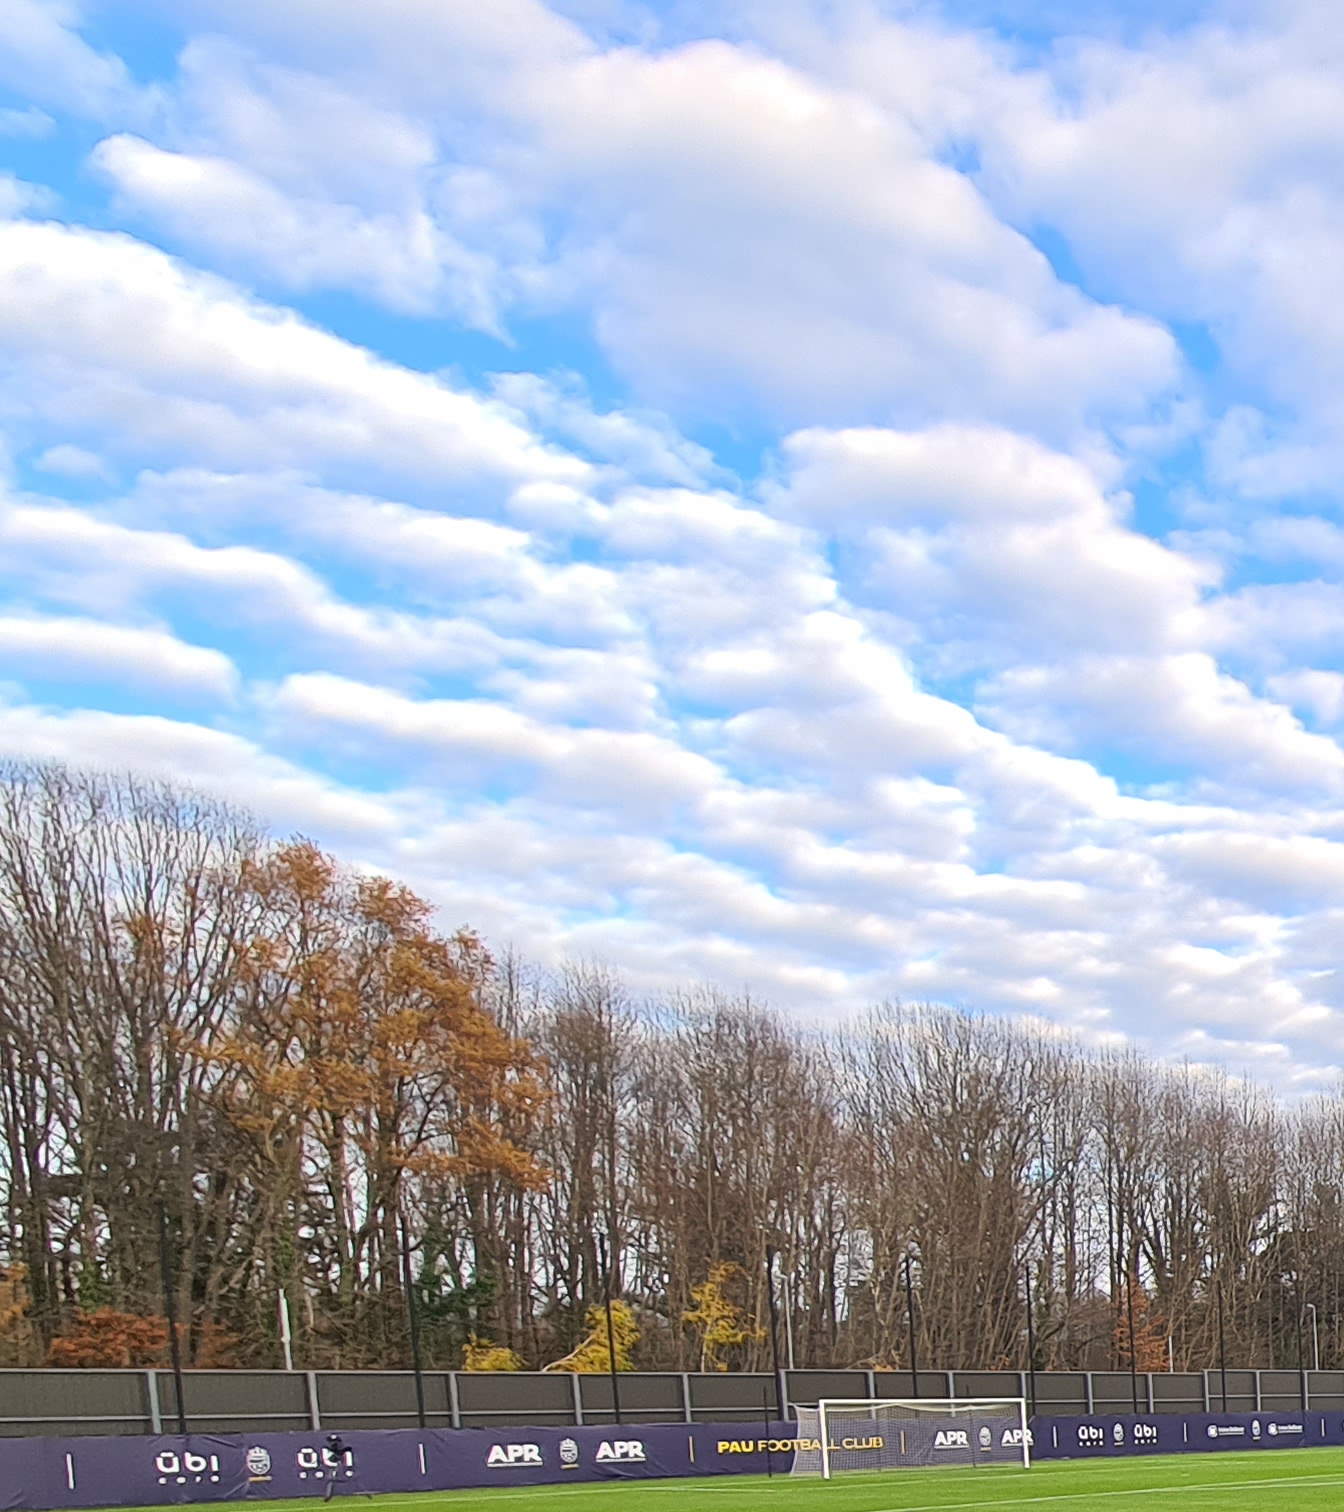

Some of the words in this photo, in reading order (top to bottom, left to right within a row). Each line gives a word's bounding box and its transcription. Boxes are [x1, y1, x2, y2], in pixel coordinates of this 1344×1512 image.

[717, 1440, 754, 1453] PAU
[842, 1436, 884, 1449] CLUB
[934, 1430, 969, 1446] APR
[1001, 1429, 1034, 1445] APR
[487, 1444, 542, 1463] APR
[595, 1440, 646, 1459] APR
